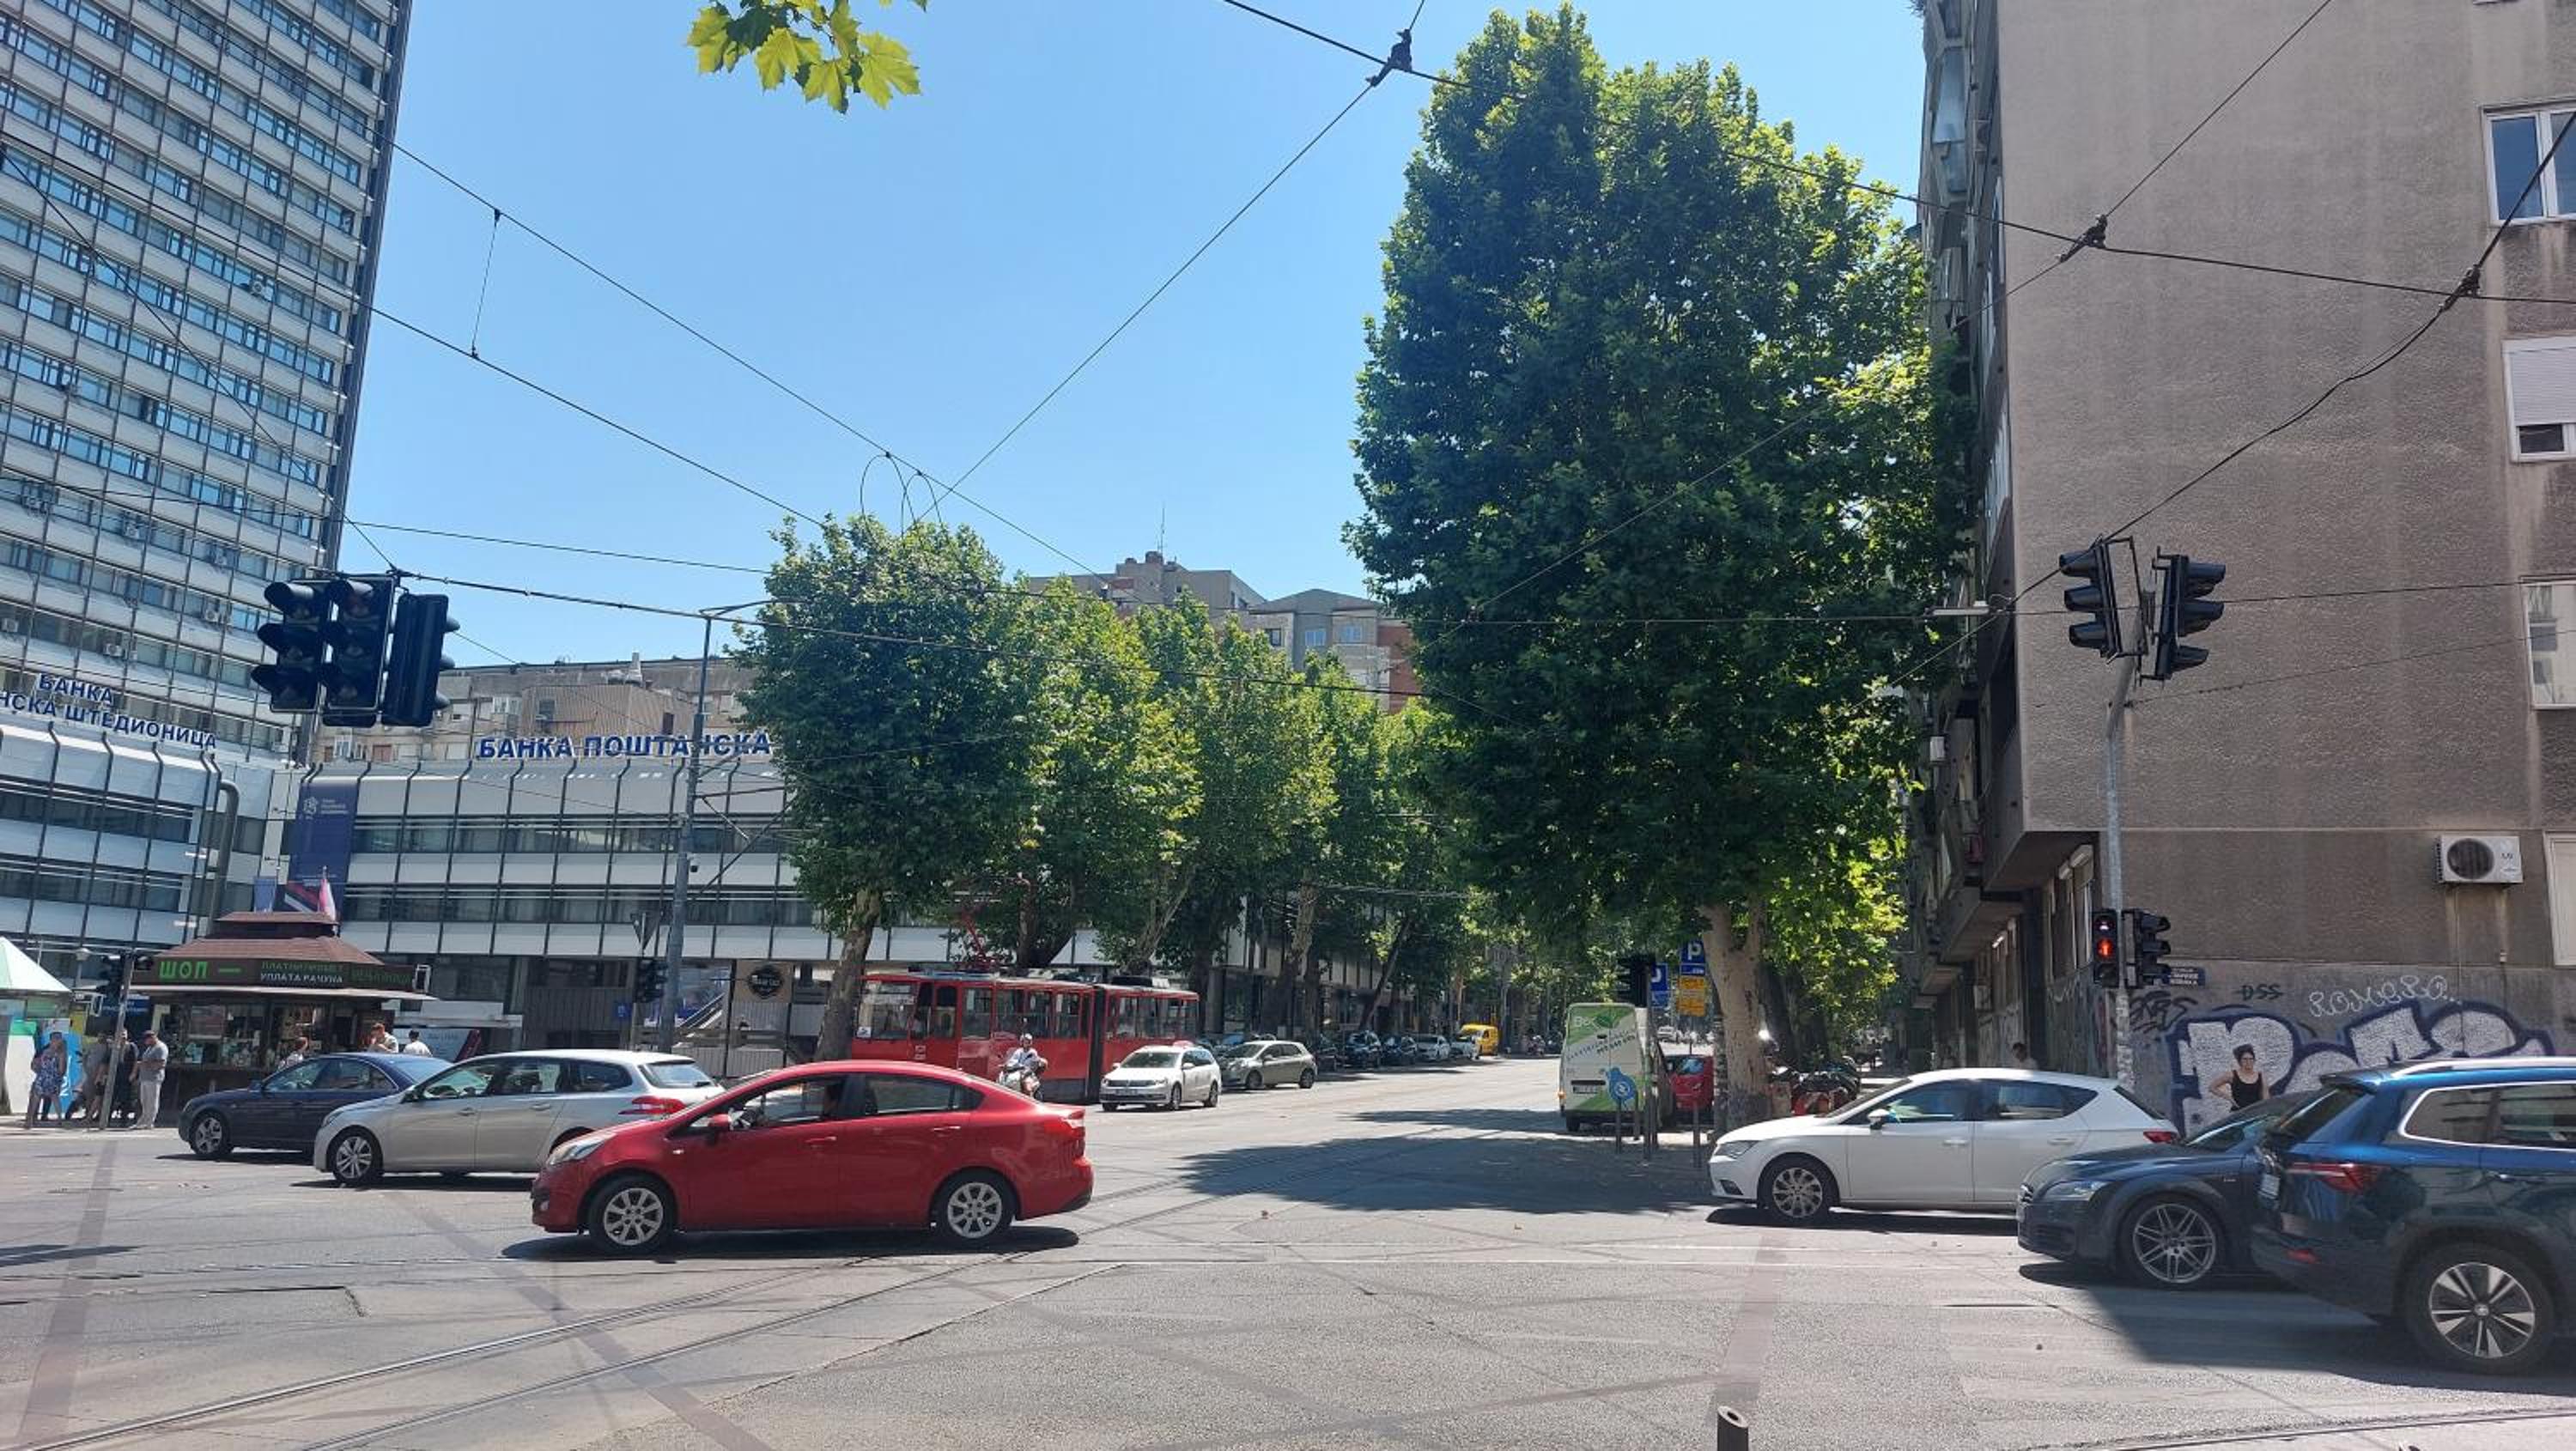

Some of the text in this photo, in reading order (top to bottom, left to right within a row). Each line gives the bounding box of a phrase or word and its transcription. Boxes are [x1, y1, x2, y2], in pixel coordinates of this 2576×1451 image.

[39, 673, 114, 706] БАНКА
[64, 705, 217, 750] ШТЕДИОНИЦА
[477, 736, 576, 758] БАНКА
[159, 961, 209, 980] ШОП
[260, 973, 301, 983] УПЛАТА
